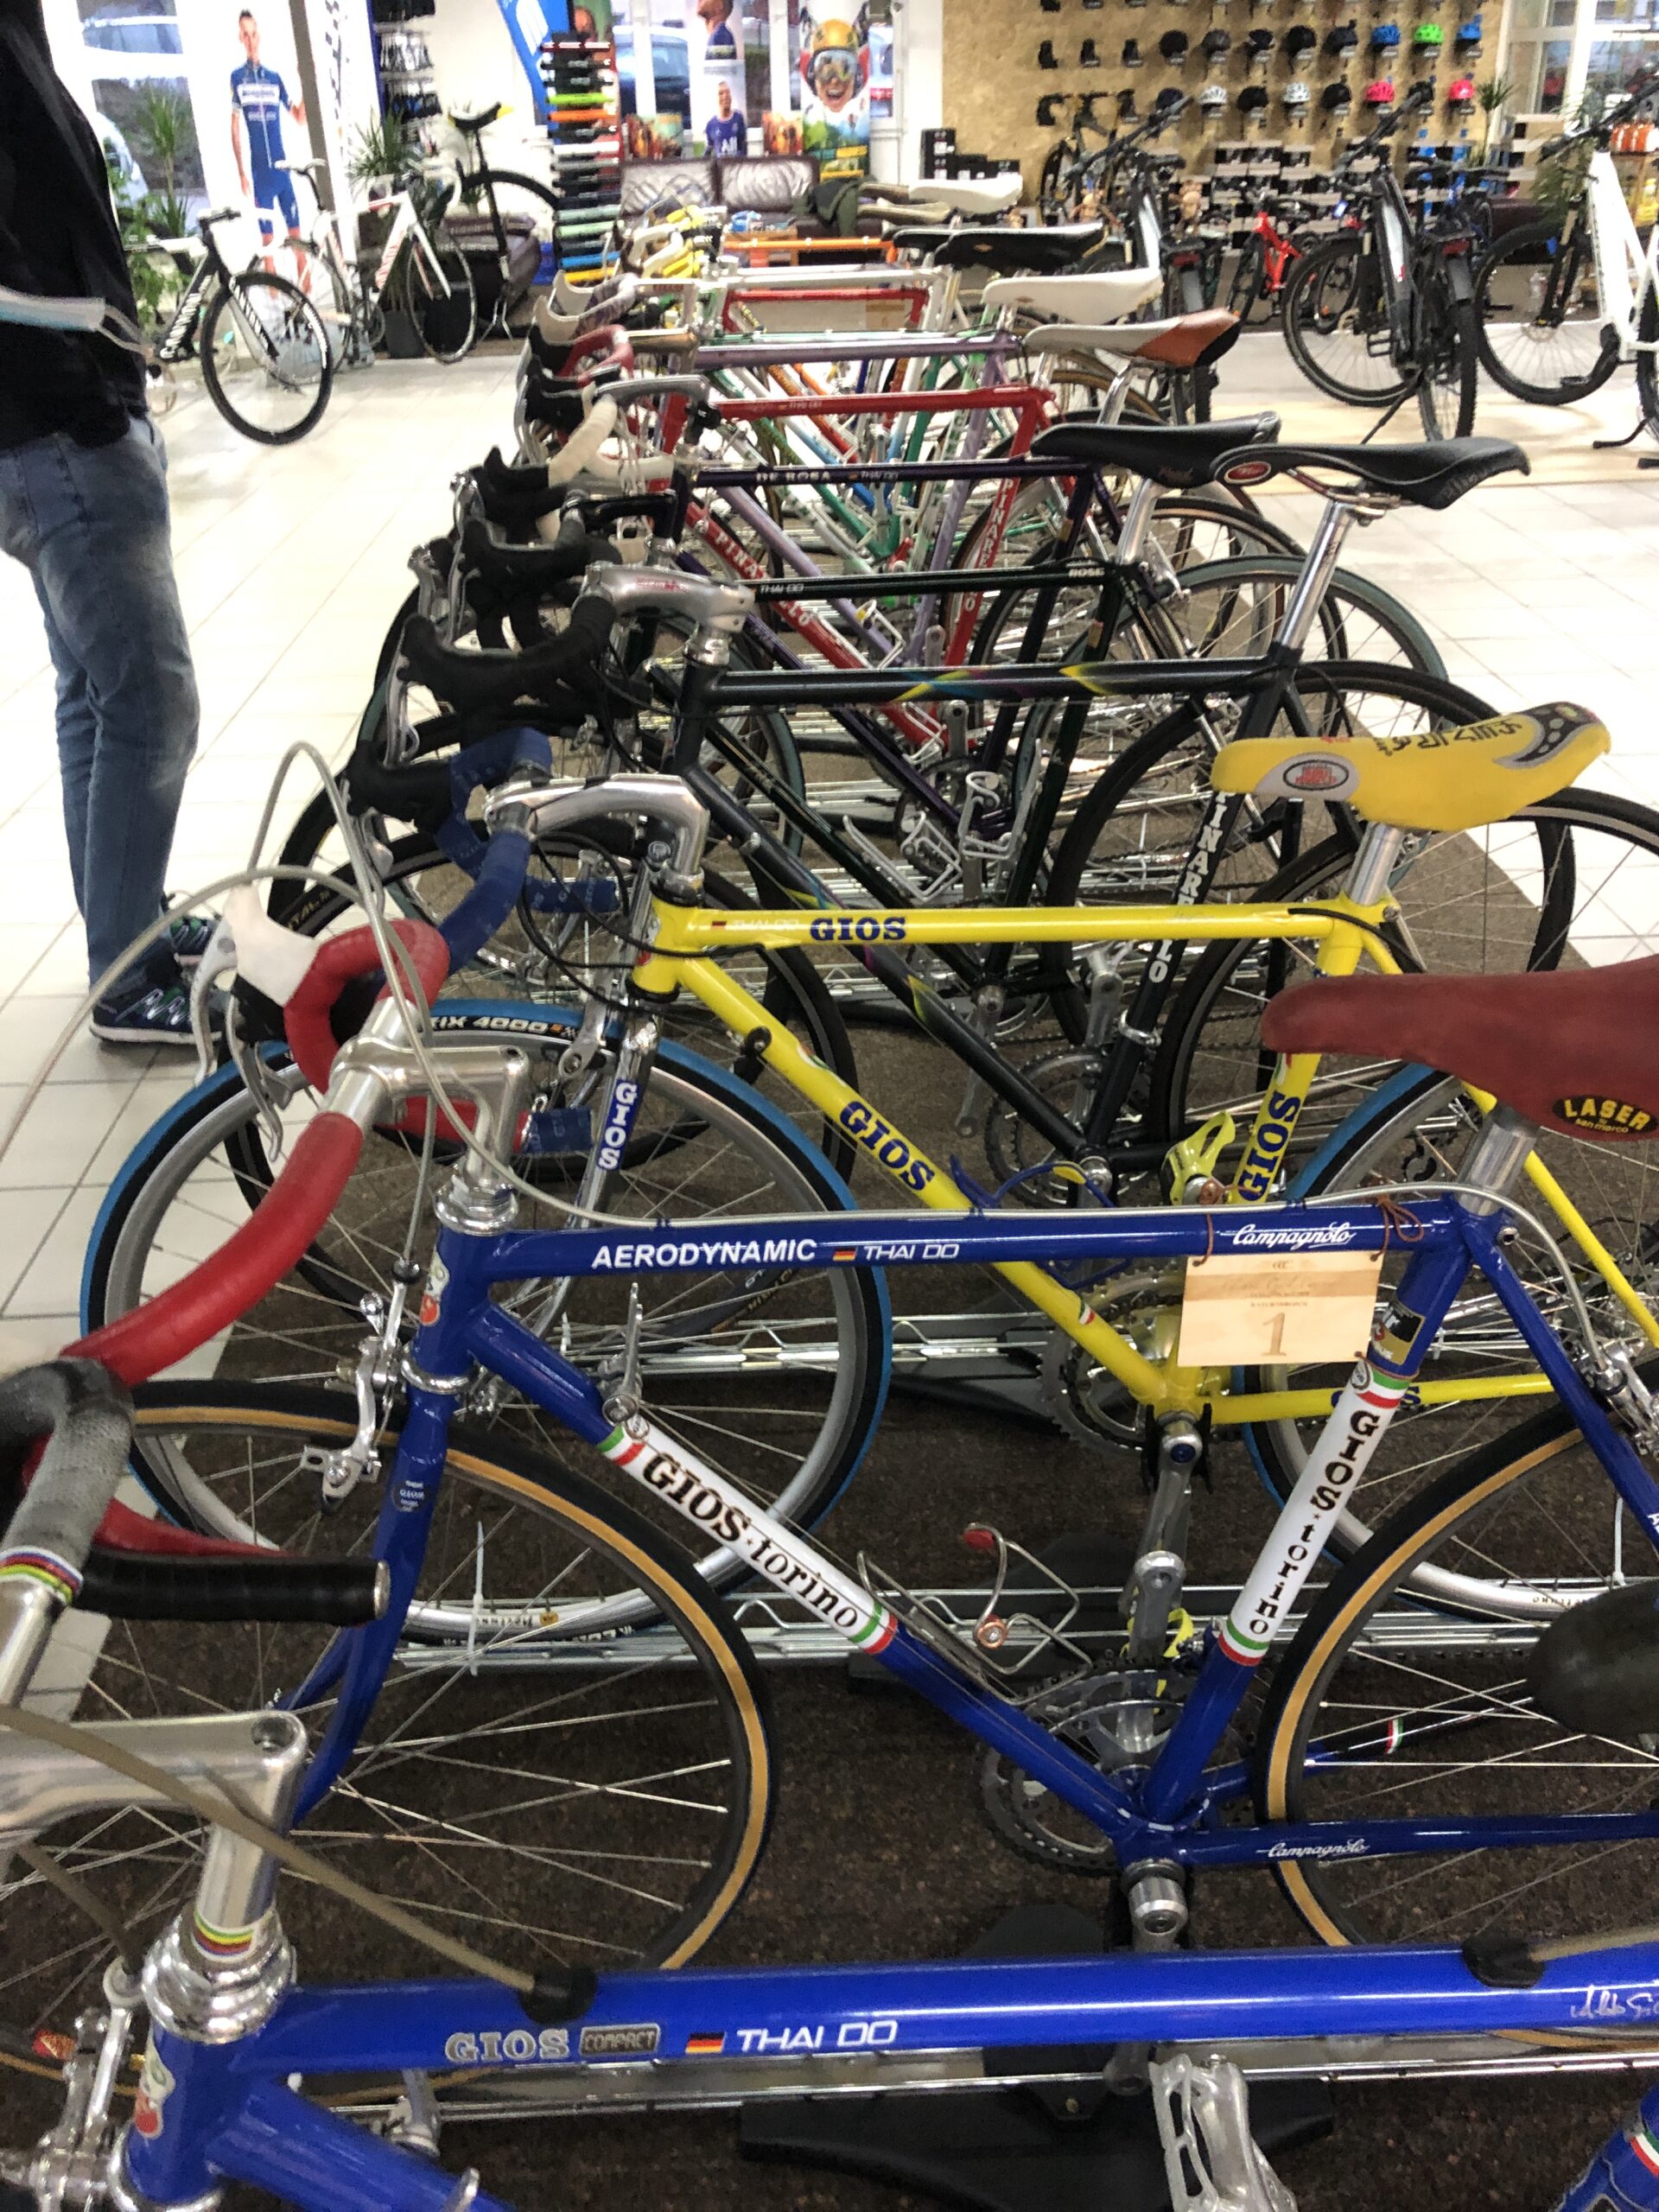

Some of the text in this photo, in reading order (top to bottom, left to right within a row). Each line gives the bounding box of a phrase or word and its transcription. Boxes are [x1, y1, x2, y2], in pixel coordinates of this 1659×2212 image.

[785, 471, 830, 481] ROSA
[714, 531, 811, 626] PINALO
[965, 478, 1014, 612] PINAREO
[1148, 791, 1236, 983] INARLO
[810, 917, 906, 941] GIOS
[473, 1016, 549, 1034] 4000
[597, 1082, 638, 1171] GIOS
[840, 1101, 936, 1191] GIOS
[1237, 1090, 1301, 1202] GIOS
[1563, 1097, 1651, 1131] LASER
[591, 1238, 960, 1269] AERODYNAMIC THAI DO
[1230, 1221, 1357, 1251] Campagnolo
[1262, 1312, 1287, 1357] 1
[1309, 1409, 1380, 1512] GIOS
[642, 1452, 860, 1629] GIOS torino
[1249, 1523, 1316, 1636] torino
[1265, 1838, 1371, 1859] Campagnolo
[444, 2019, 899, 2063] GIOS COMPACT THAI DO
